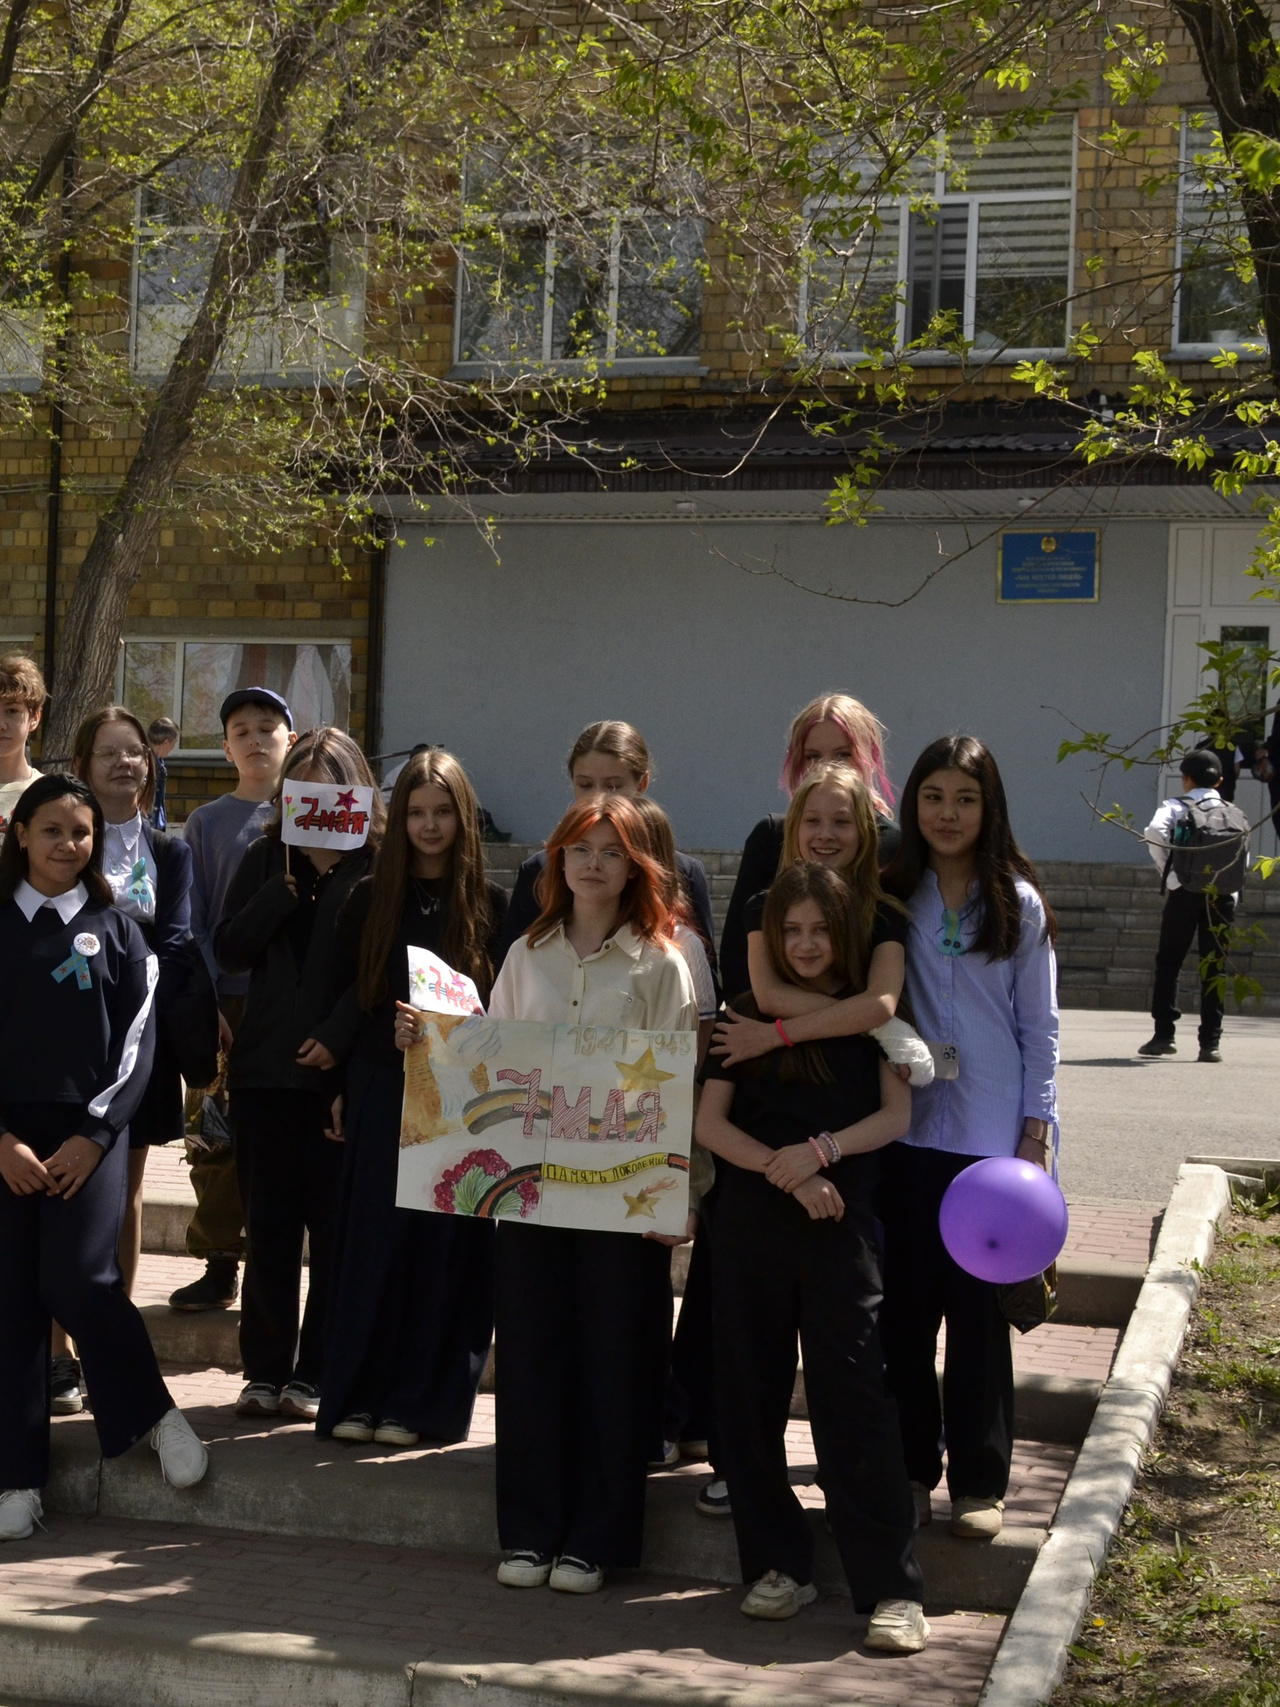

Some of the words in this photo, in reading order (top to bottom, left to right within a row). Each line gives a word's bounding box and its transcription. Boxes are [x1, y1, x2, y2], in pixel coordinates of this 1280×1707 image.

[301, 796, 319, 831] 7
[318, 809, 366, 835] мая
[429, 965, 442, 1001] 7
[496, 1068, 543, 1136] 7
[551, 1085, 661, 1142] МАЯ
[546, 1164, 607, 1183] ПАМЯТЬ
